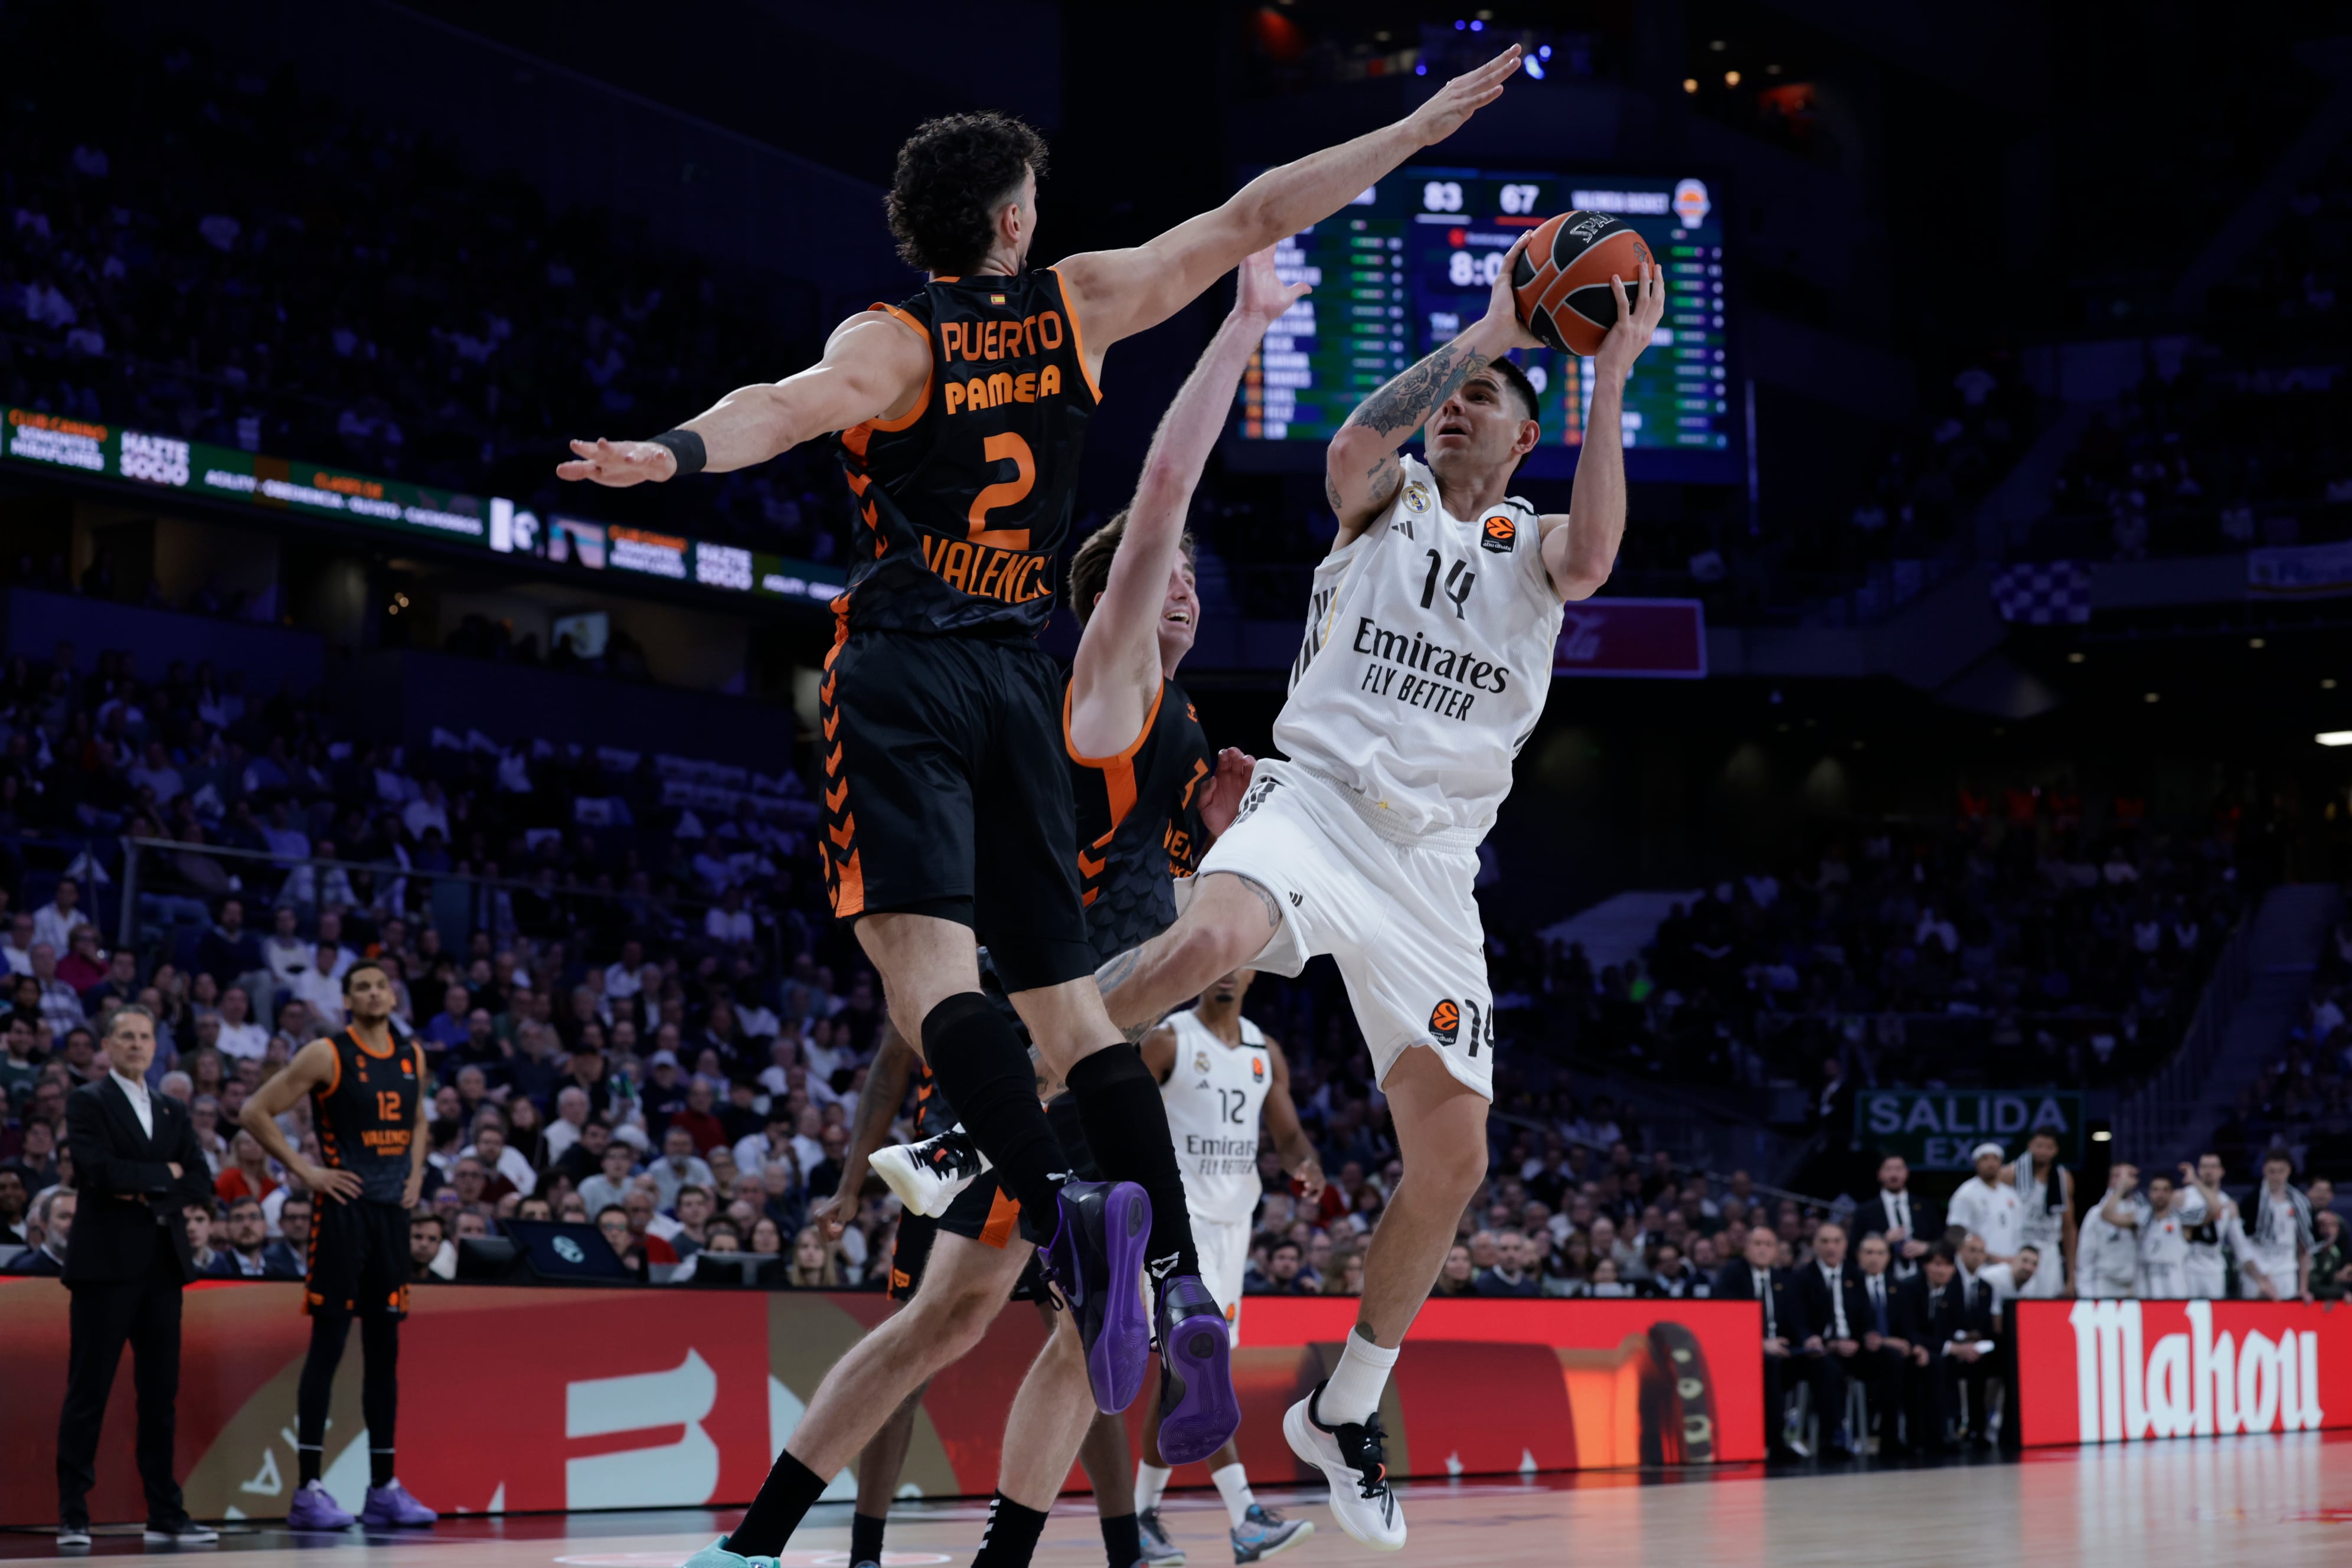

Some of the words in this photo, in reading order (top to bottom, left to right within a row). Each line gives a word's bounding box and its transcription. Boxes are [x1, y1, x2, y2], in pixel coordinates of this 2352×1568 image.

[1423, 181, 1463, 212] 83
[1500, 184, 1540, 214] 67
[1569, 214, 1618, 243] SPAL
[1449, 251, 1507, 287] 8:0
[940, 309, 1063, 362] PUERTO
[944, 364, 1061, 416] PAMEA
[966, 432, 1037, 551] 2
[922, 534, 1053, 603] VALENC
[1420, 548, 1475, 620] 14
[1353, 616, 1509, 694] Emirates
[1361, 664, 1398, 697] FLY
[1397, 674, 1475, 721] BETTER
[376, 1090, 403, 1121] 12
[1218, 1089, 1245, 1124] 12
[1868, 1095, 2070, 1135] SALIDA
[1187, 1135, 1256, 1156] Emira
[1923, 1136, 2014, 1165] EX
[2068, 1299, 2324, 1445] Mahou
